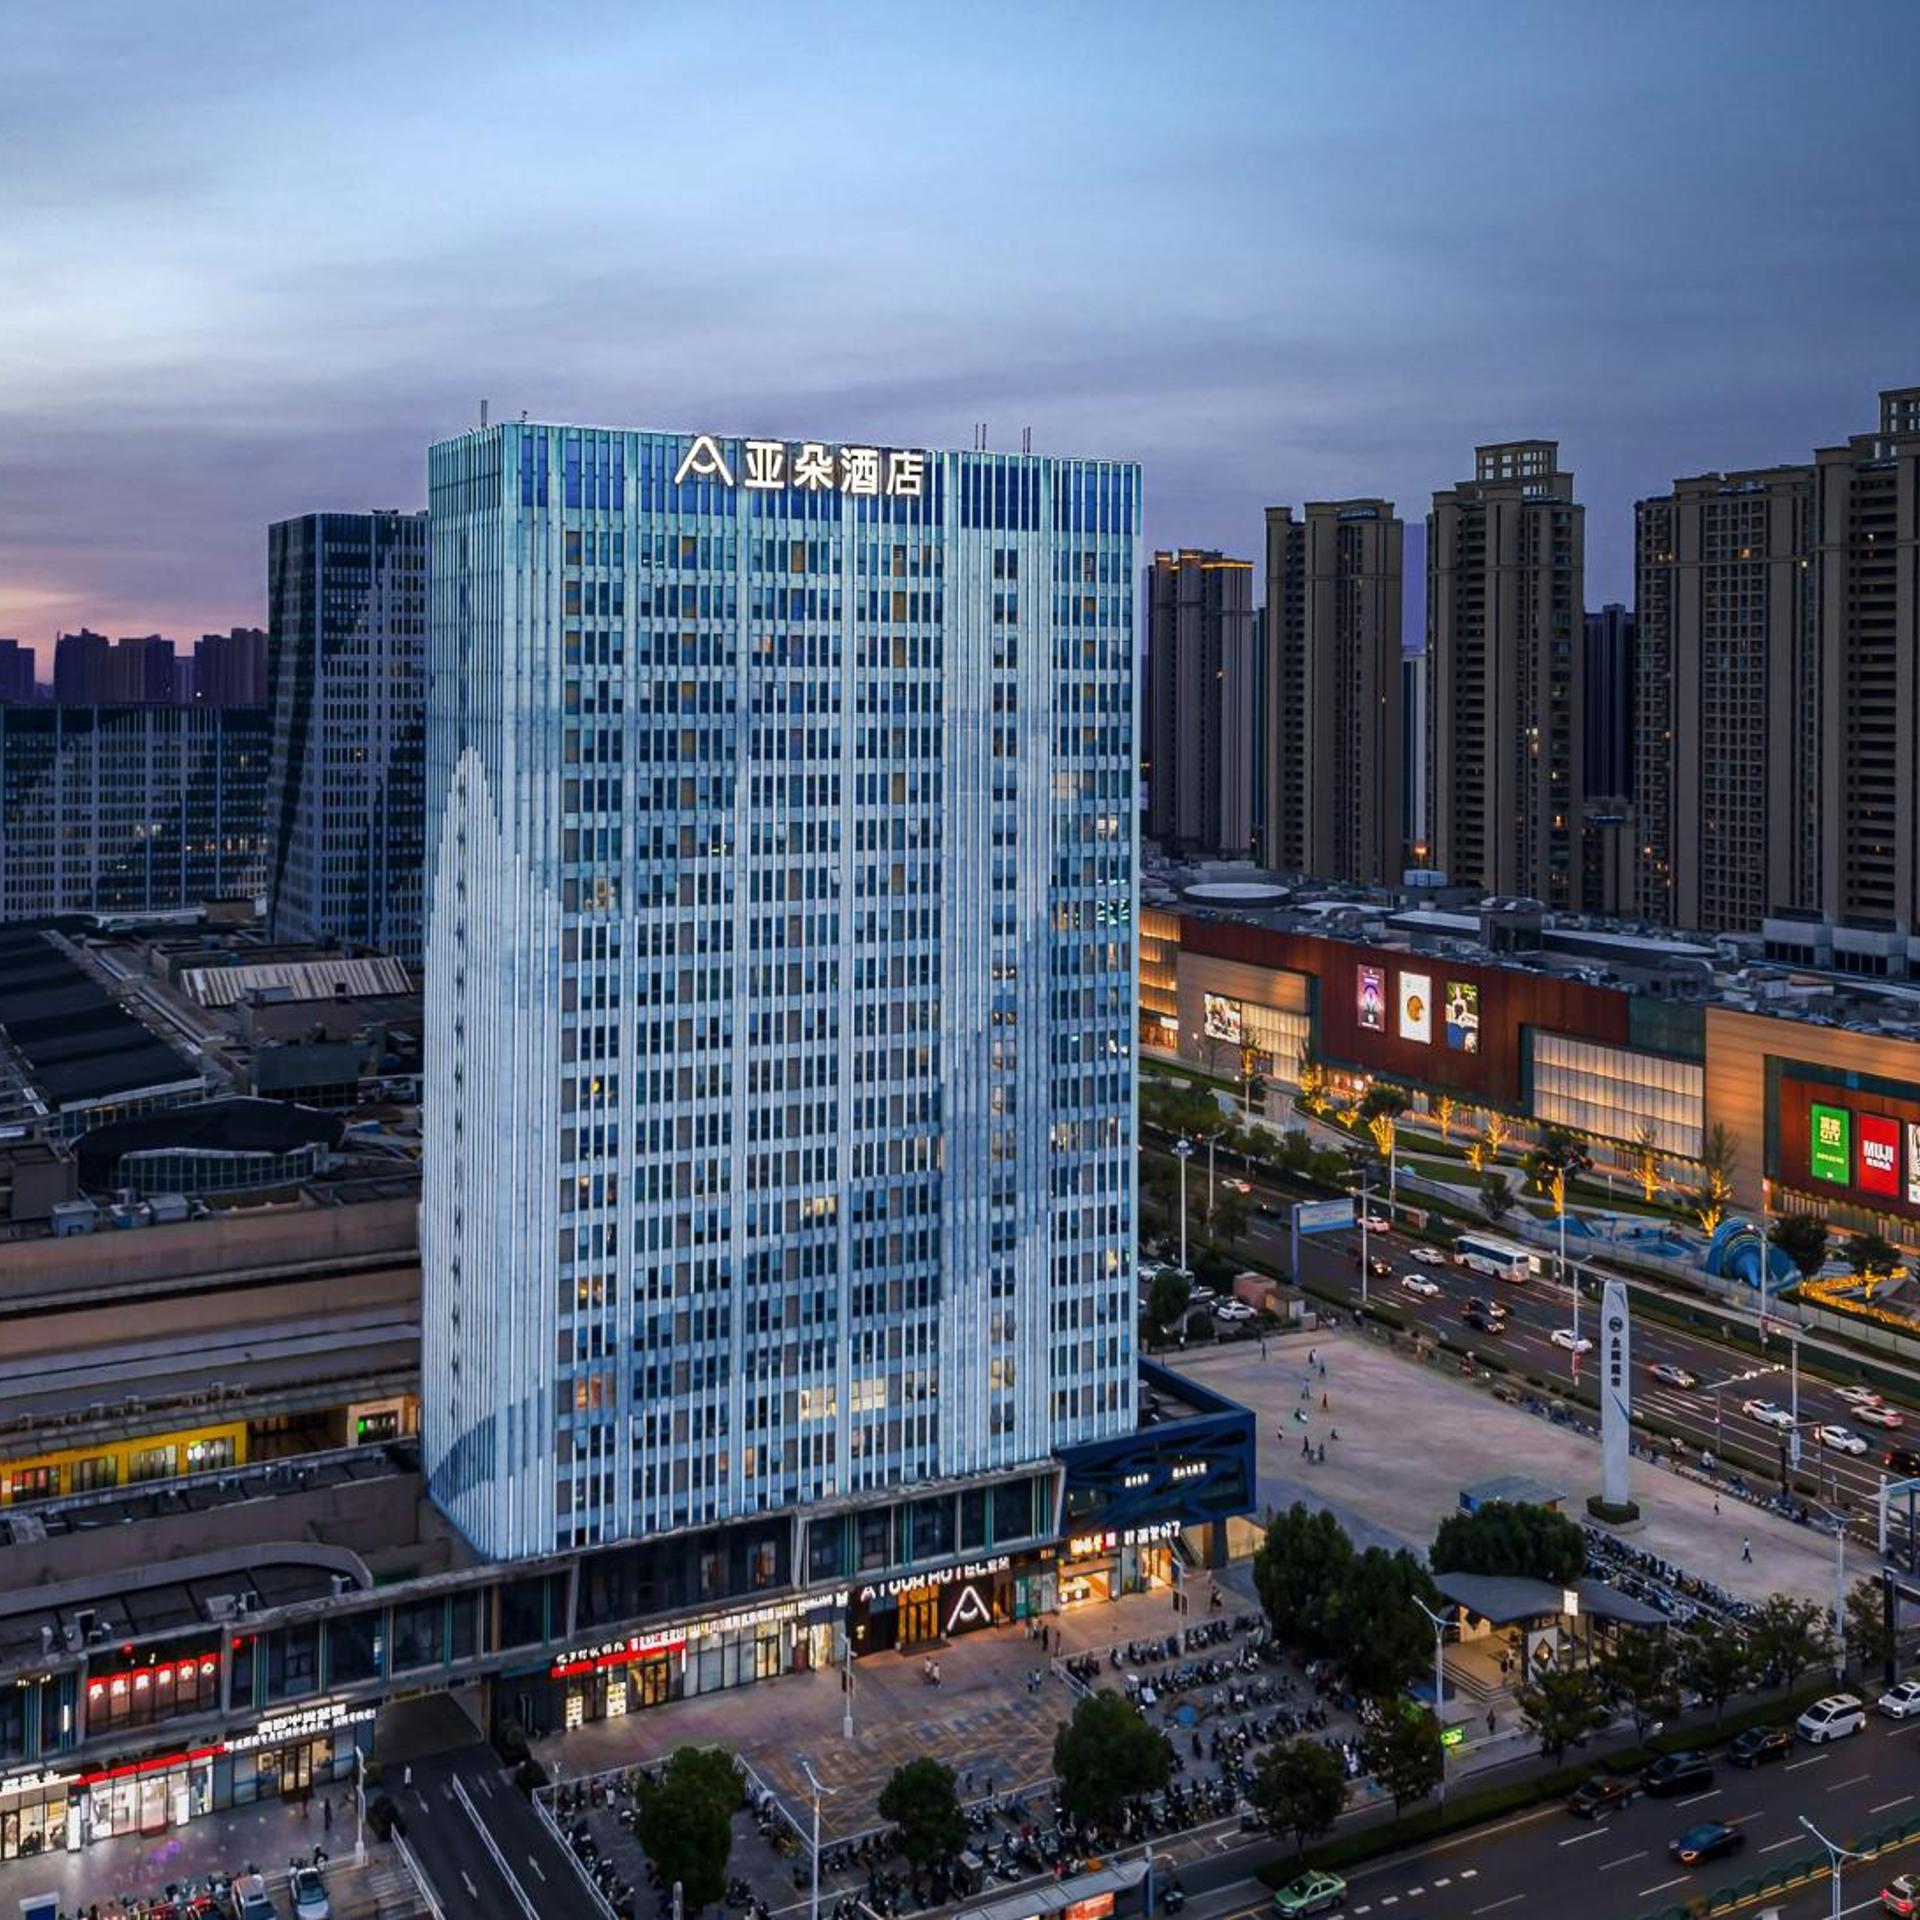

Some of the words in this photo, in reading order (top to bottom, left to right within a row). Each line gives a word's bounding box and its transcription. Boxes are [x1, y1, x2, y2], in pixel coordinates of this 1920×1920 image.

[744, 441, 924, 496] 亚朵酒店
[1863, 1140, 1894, 1164] MUJI
[861, 1574, 924, 1602] ATOUR
